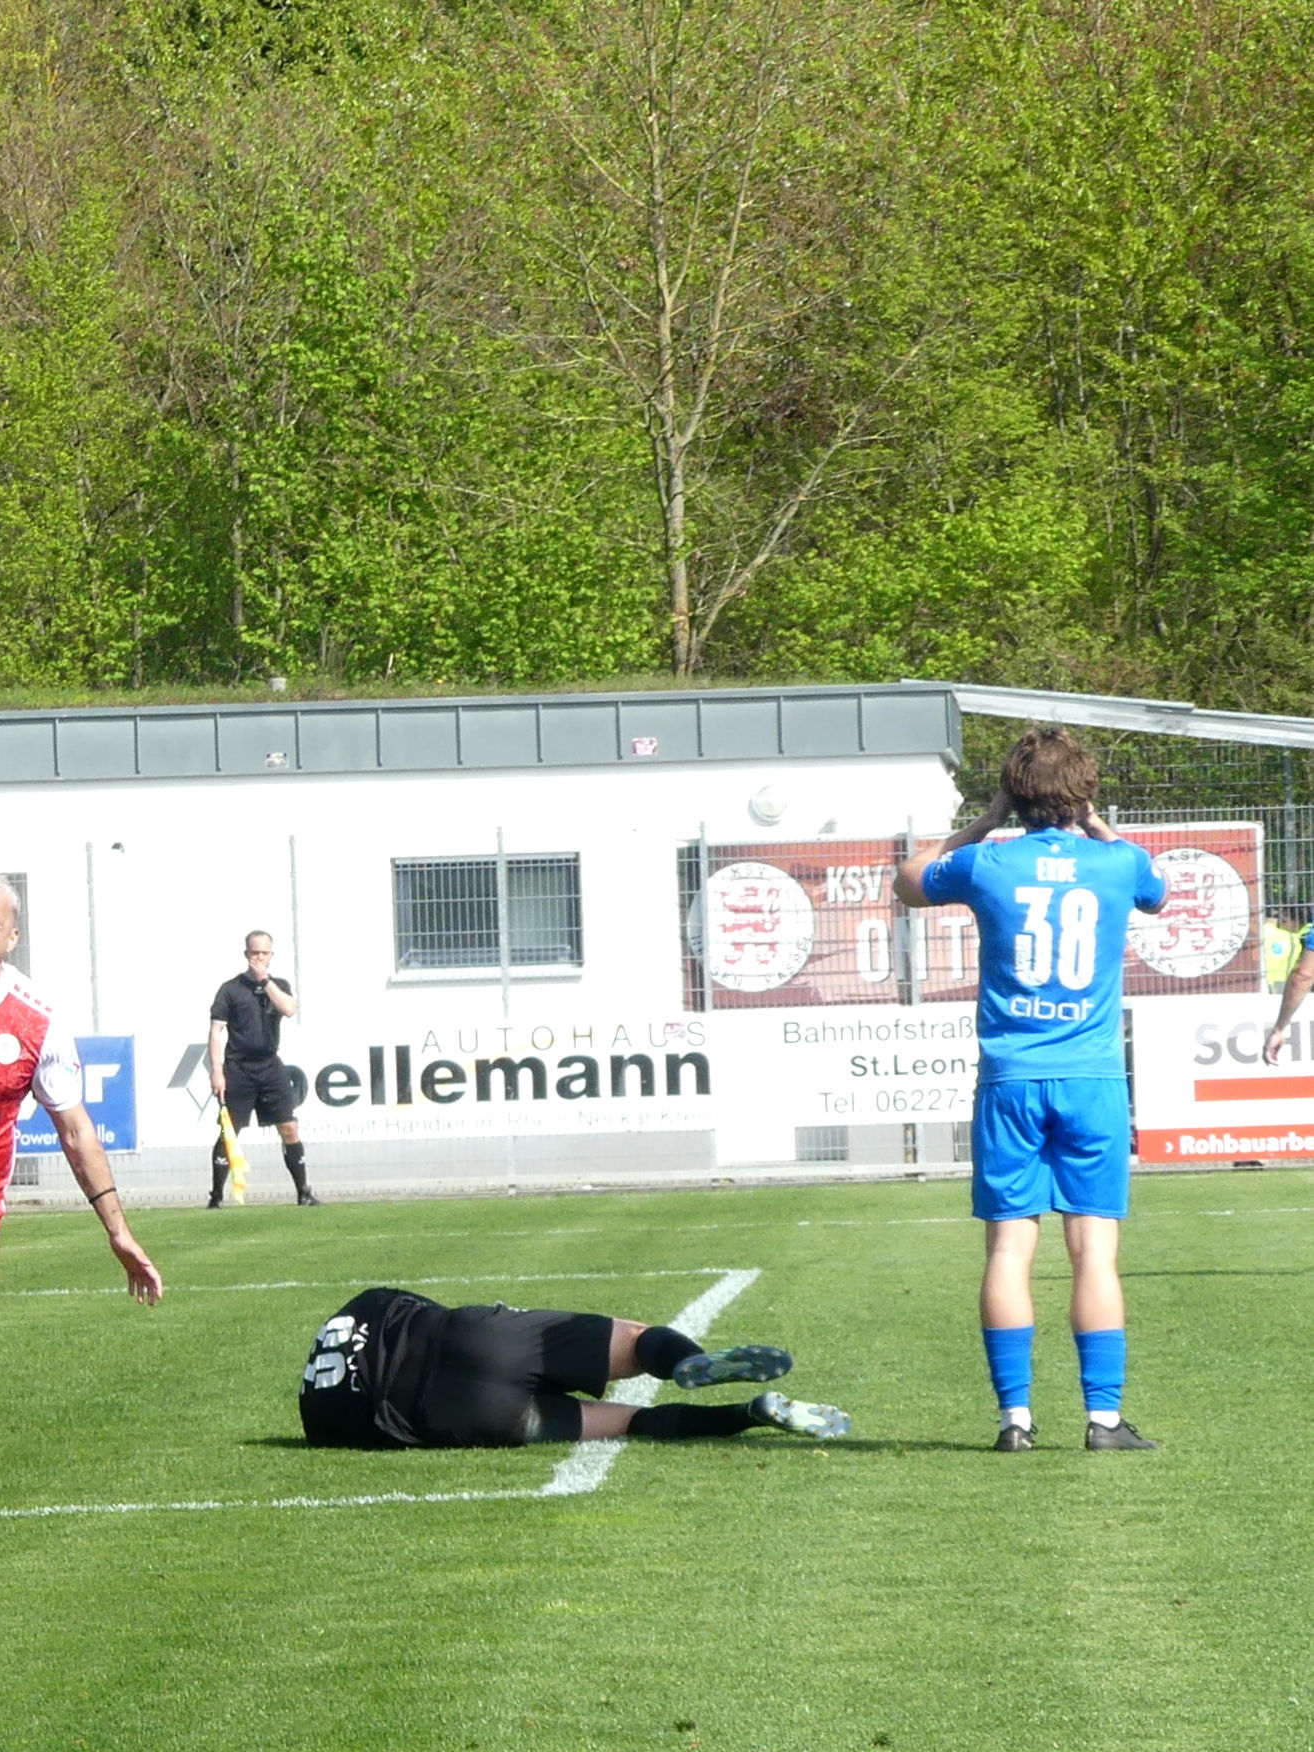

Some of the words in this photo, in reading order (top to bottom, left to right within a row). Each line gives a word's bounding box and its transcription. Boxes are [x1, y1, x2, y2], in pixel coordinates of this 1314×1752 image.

[826, 865, 883, 903] KSV
[1014, 887, 1099, 990] 38
[1009, 997, 1094, 1021] abat
[421, 1021, 707, 1053] AUTOHAUS
[783, 1016, 974, 1044] Bahnhofstraß
[850, 1054, 978, 1077] St.Leon-
[819, 1091, 863, 1114] Tel.
[876, 1088, 967, 1113] 06227-
